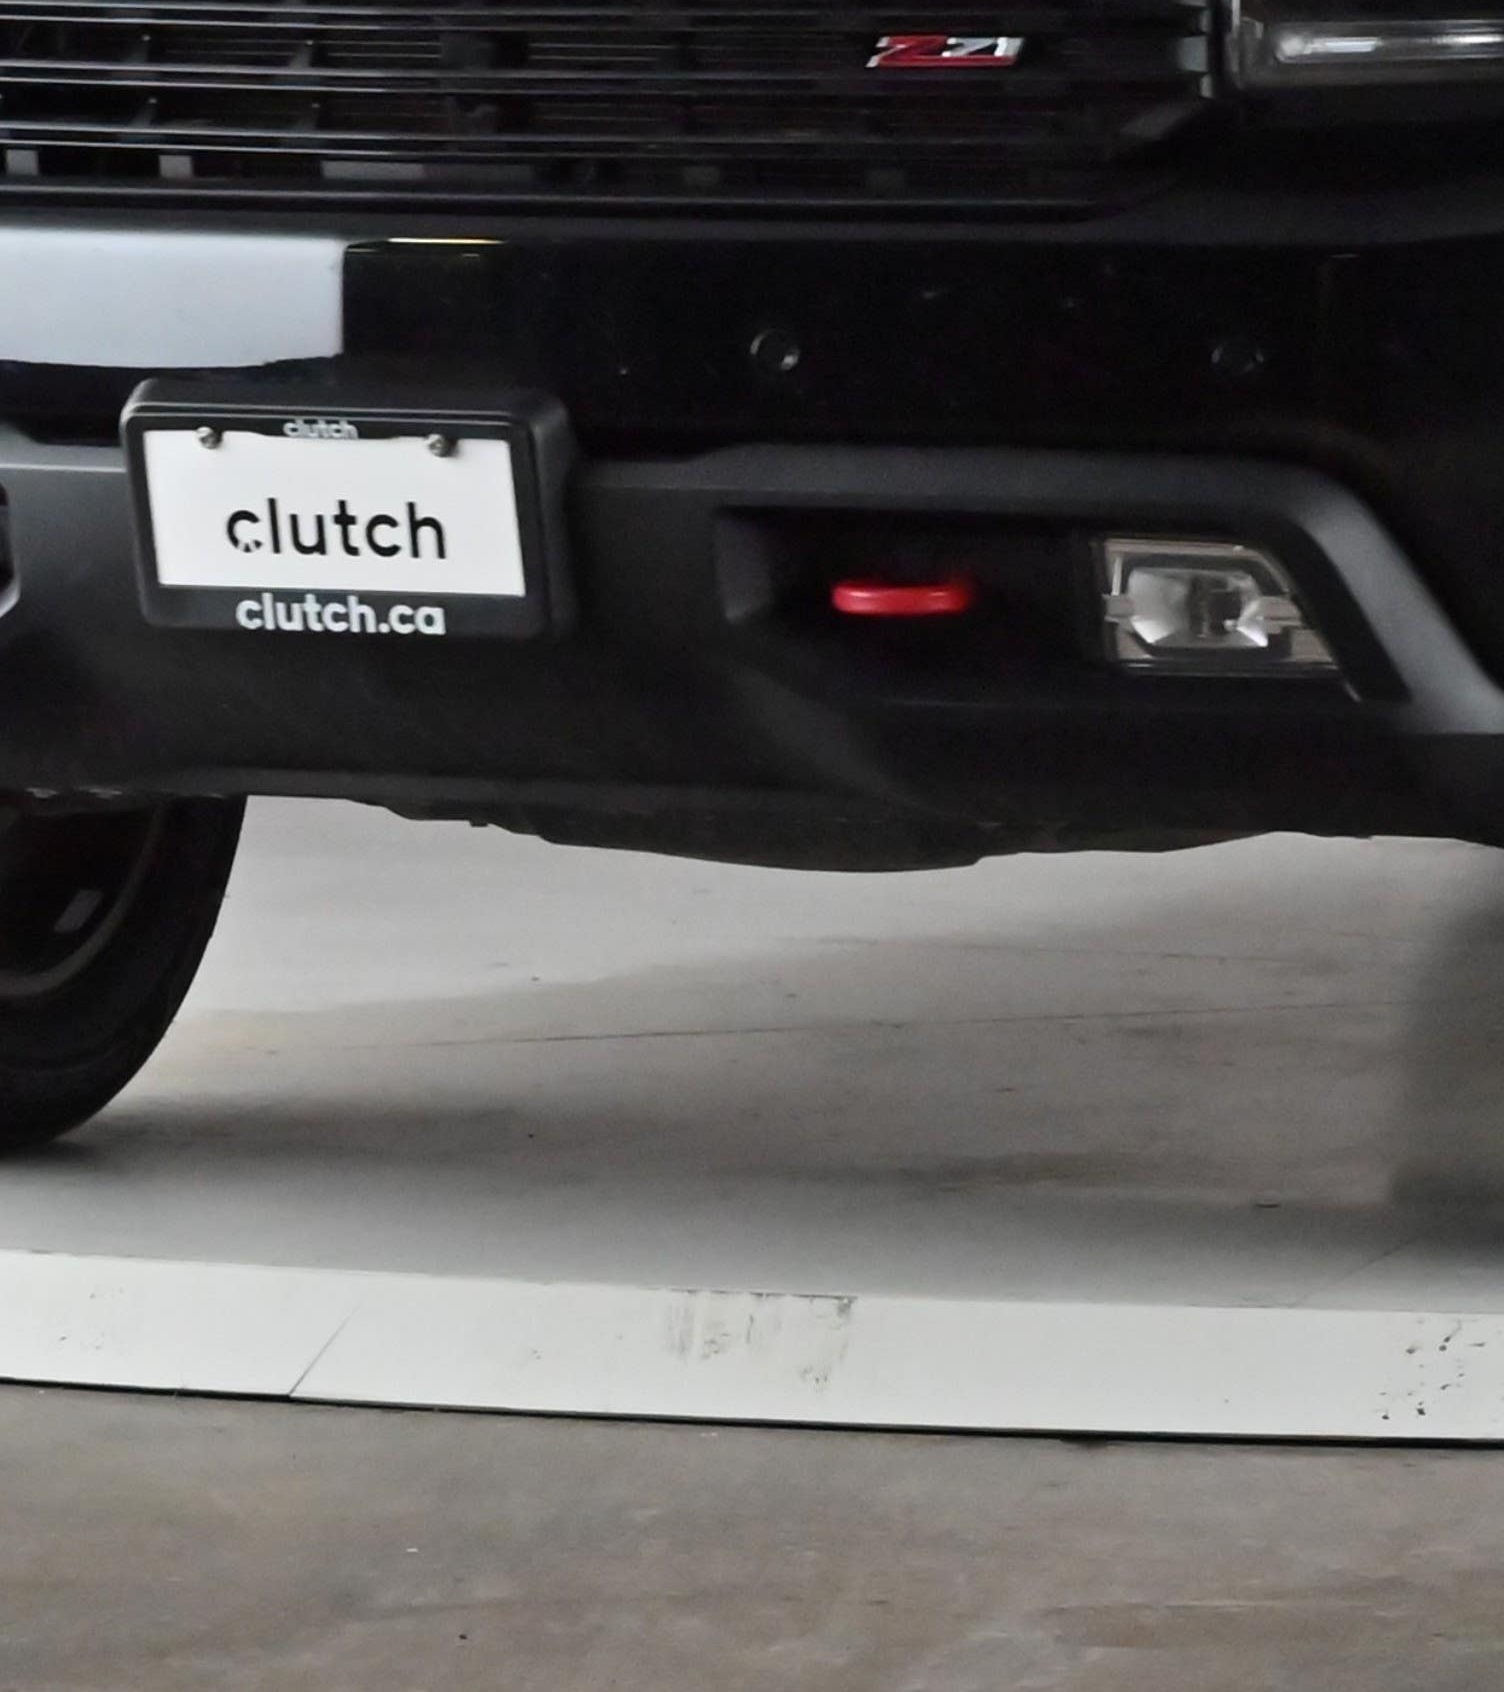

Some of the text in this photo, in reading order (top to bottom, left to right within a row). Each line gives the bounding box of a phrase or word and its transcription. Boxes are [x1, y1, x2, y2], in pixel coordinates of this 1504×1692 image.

[866, 30, 1024, 68] Z71
[283, 418, 359, 439] clutch
[227, 497, 446, 560] clutch
[236, 592, 446, 635] clutch.ca
